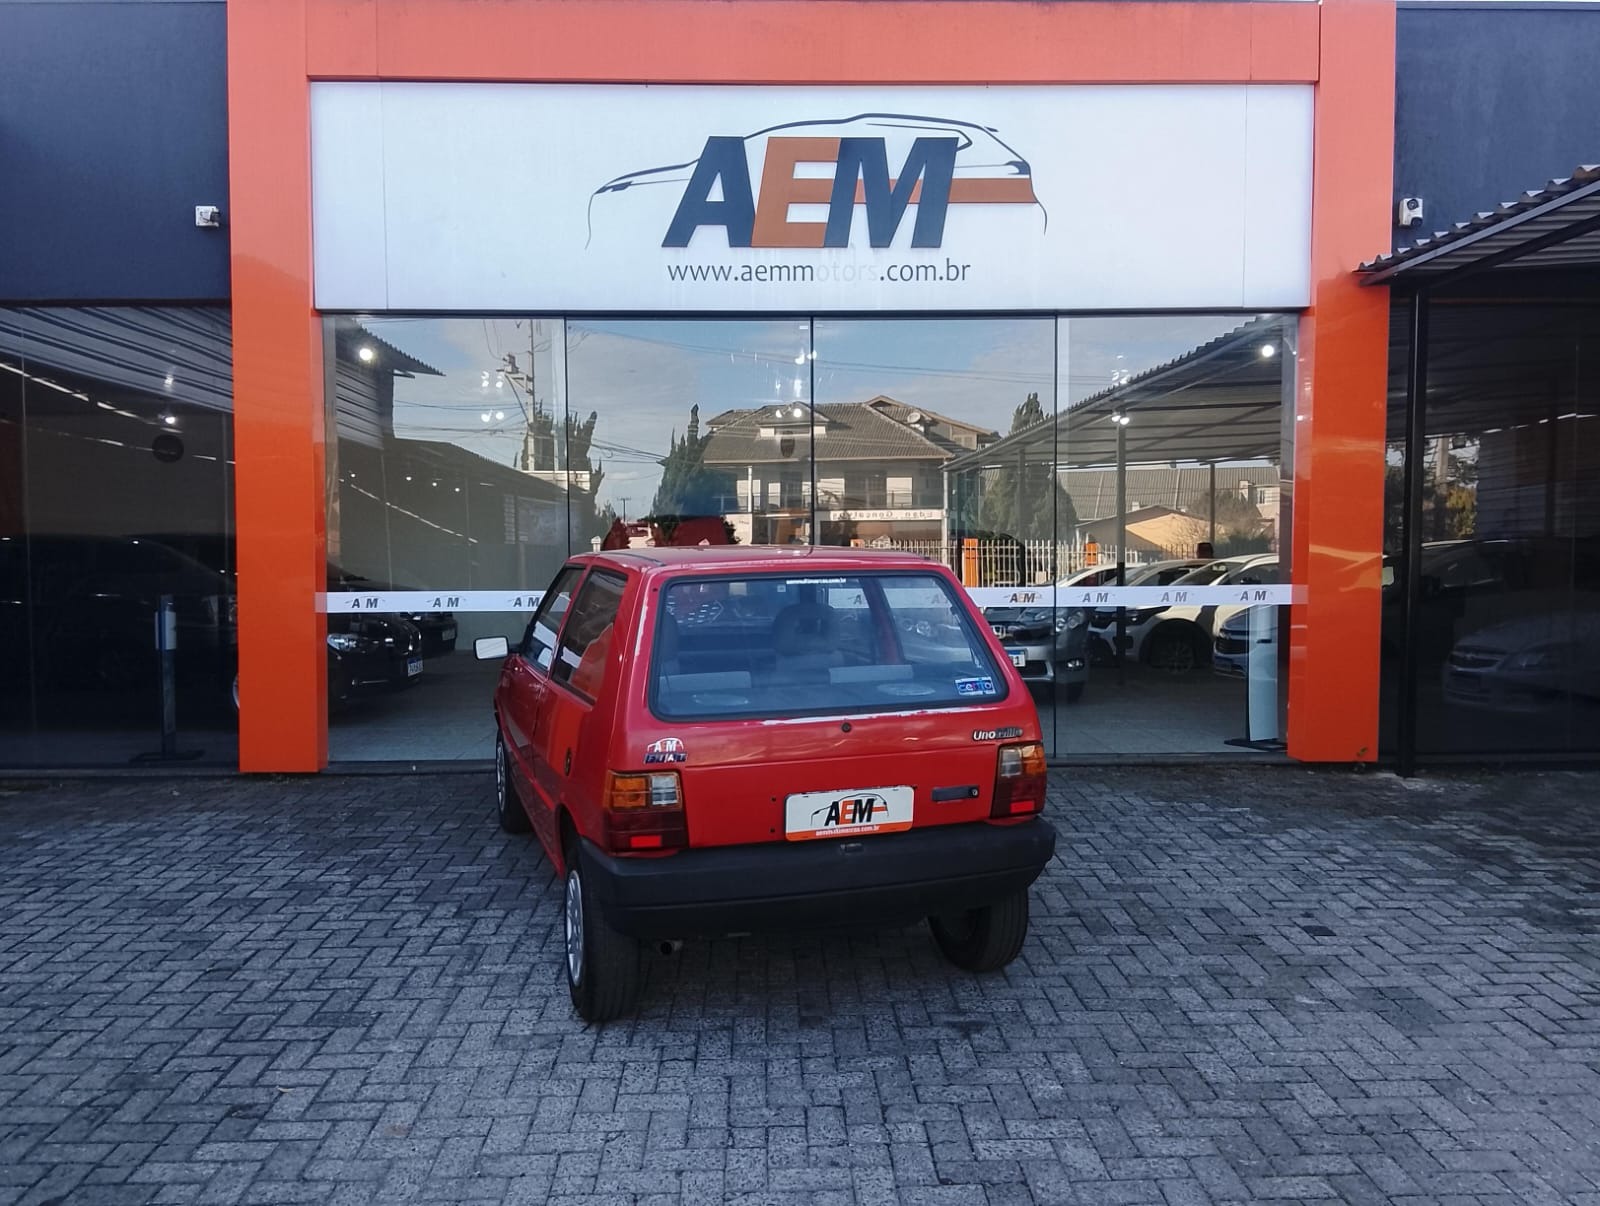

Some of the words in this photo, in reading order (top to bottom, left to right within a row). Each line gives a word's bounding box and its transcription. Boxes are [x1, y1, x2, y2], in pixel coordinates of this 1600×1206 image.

[661, 136, 959, 248] AEM
[973, 730, 996, 741] Uno
[824, 798, 876, 826] AEM
